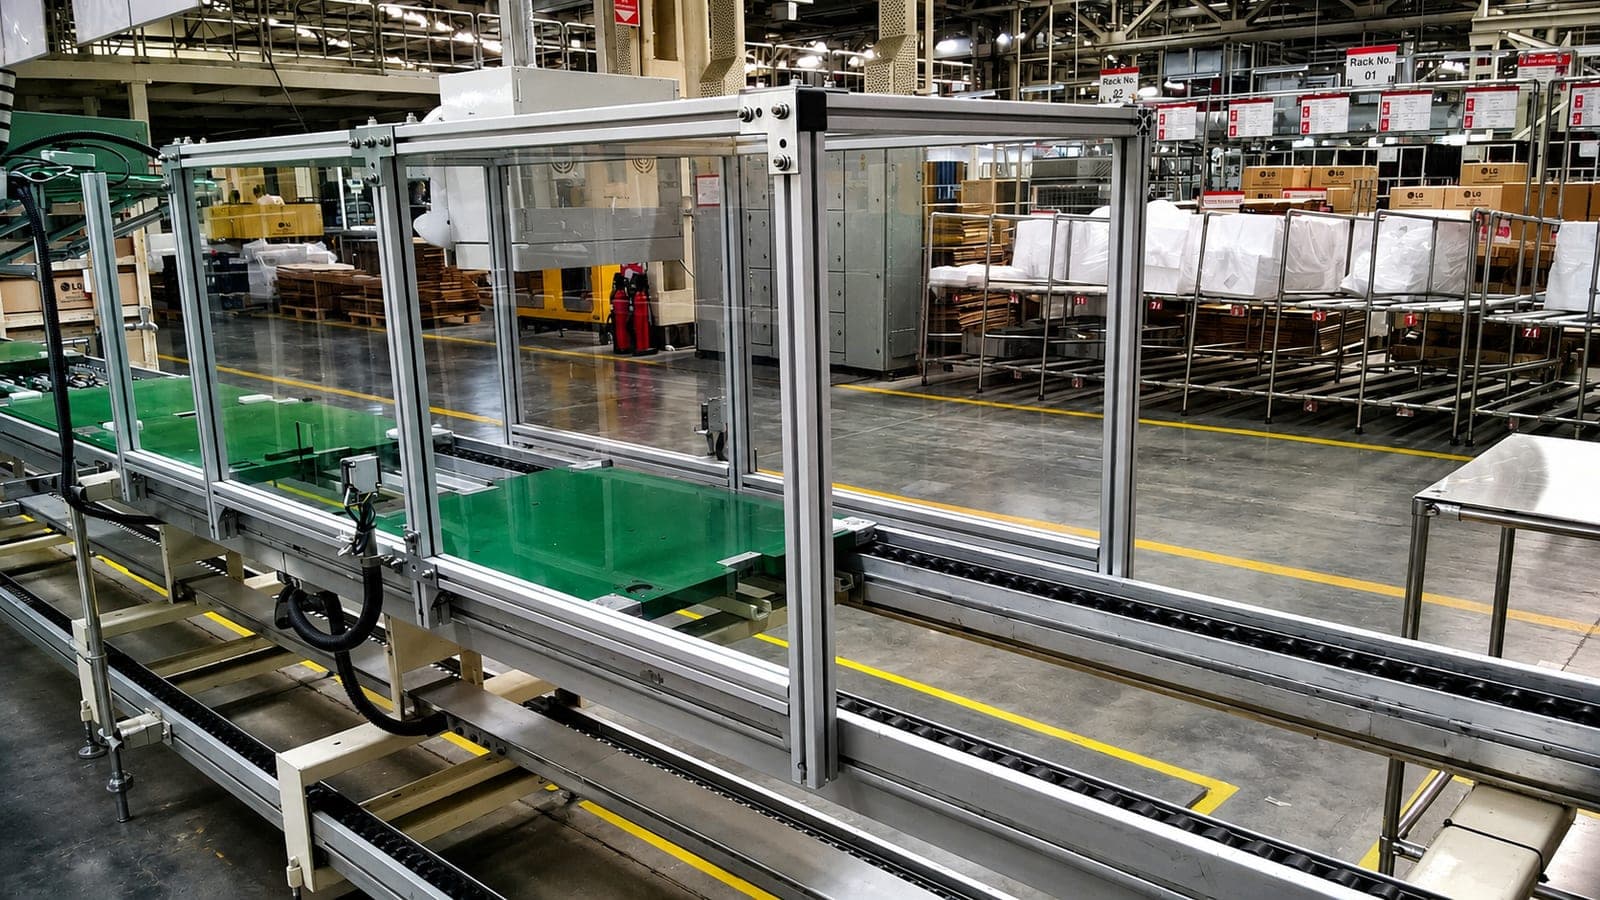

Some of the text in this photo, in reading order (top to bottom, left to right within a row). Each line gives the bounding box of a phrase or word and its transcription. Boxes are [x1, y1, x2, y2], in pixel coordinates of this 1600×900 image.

[1350, 57, 1374, 67] Rack
[1365, 71, 1376, 80] 01
[1102, 76, 1121, 86] Rack
